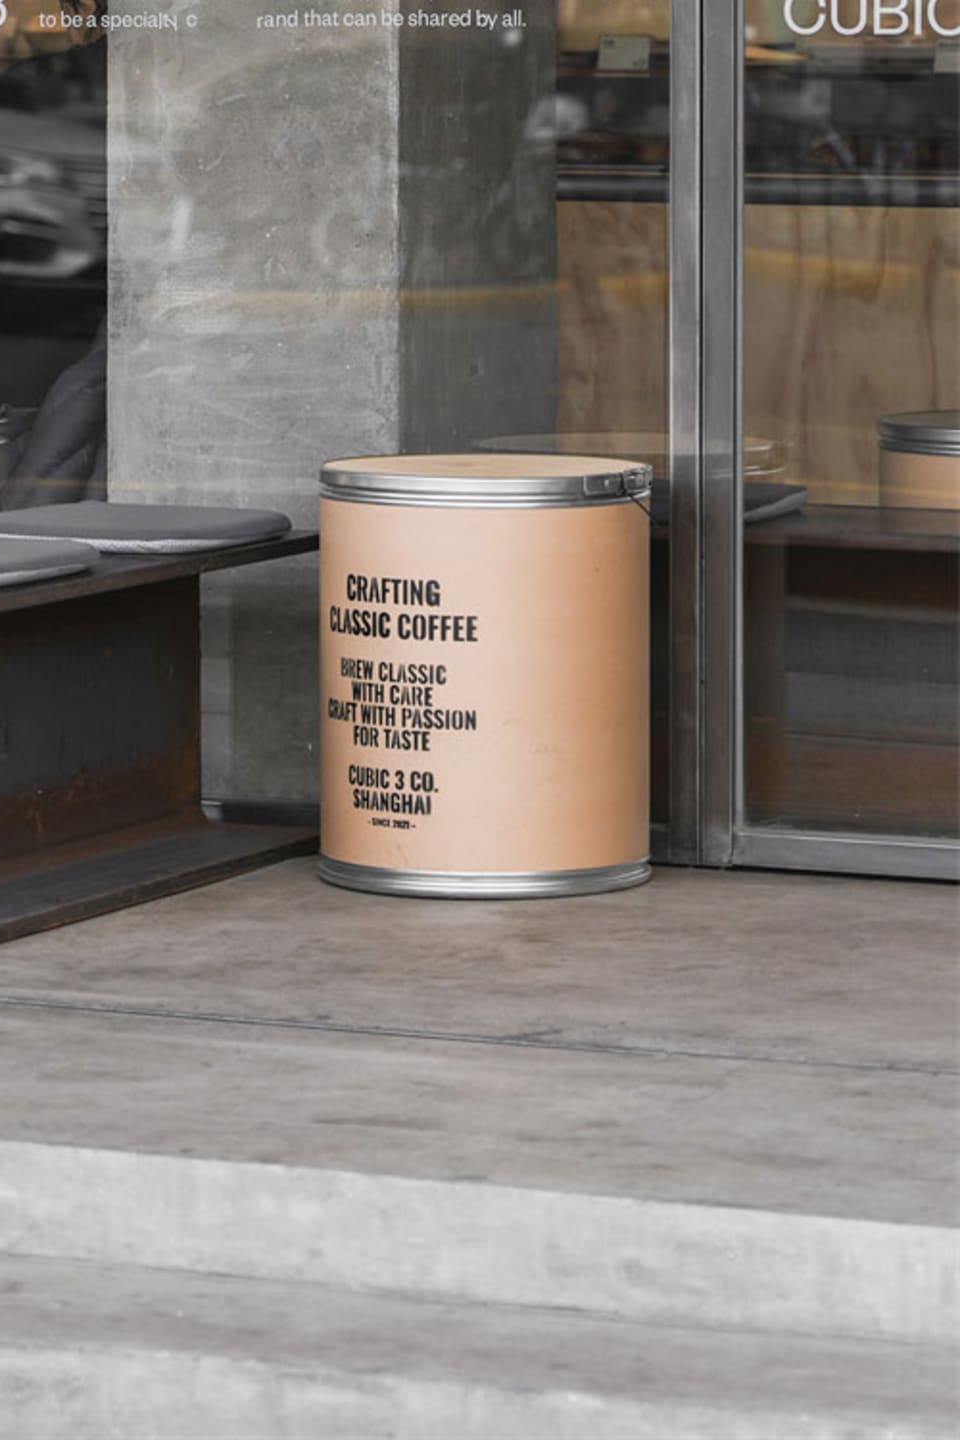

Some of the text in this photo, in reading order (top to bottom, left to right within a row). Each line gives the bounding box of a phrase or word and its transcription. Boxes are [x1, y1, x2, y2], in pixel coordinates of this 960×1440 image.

[38, 12, 56, 28] to
[60, 11, 82, 29] be
[86, 16, 97, 29] a
[304, 10, 340, 28] that
[343, 14, 377, 28] can
[381, 9, 404, 27] be
[408, 9, 472, 28] shared
[475, 9, 498, 31] by
[502, 9, 527, 28] all.
[347, 574, 441, 606] CRAFTING
[330, 606, 478, 642] CLASSIC COFFEE
[341, 657, 447, 684] BREW CLASSIC
[352, 682, 433, 706] WITH CARE
[328, 698, 477, 730] CRAFT WITH PASSION
[353, 726, 430, 751] FOR TASTE
[348, 764, 439, 793] CUBIC 3 CO.
[353, 789, 431, 815] SHANGHAI
